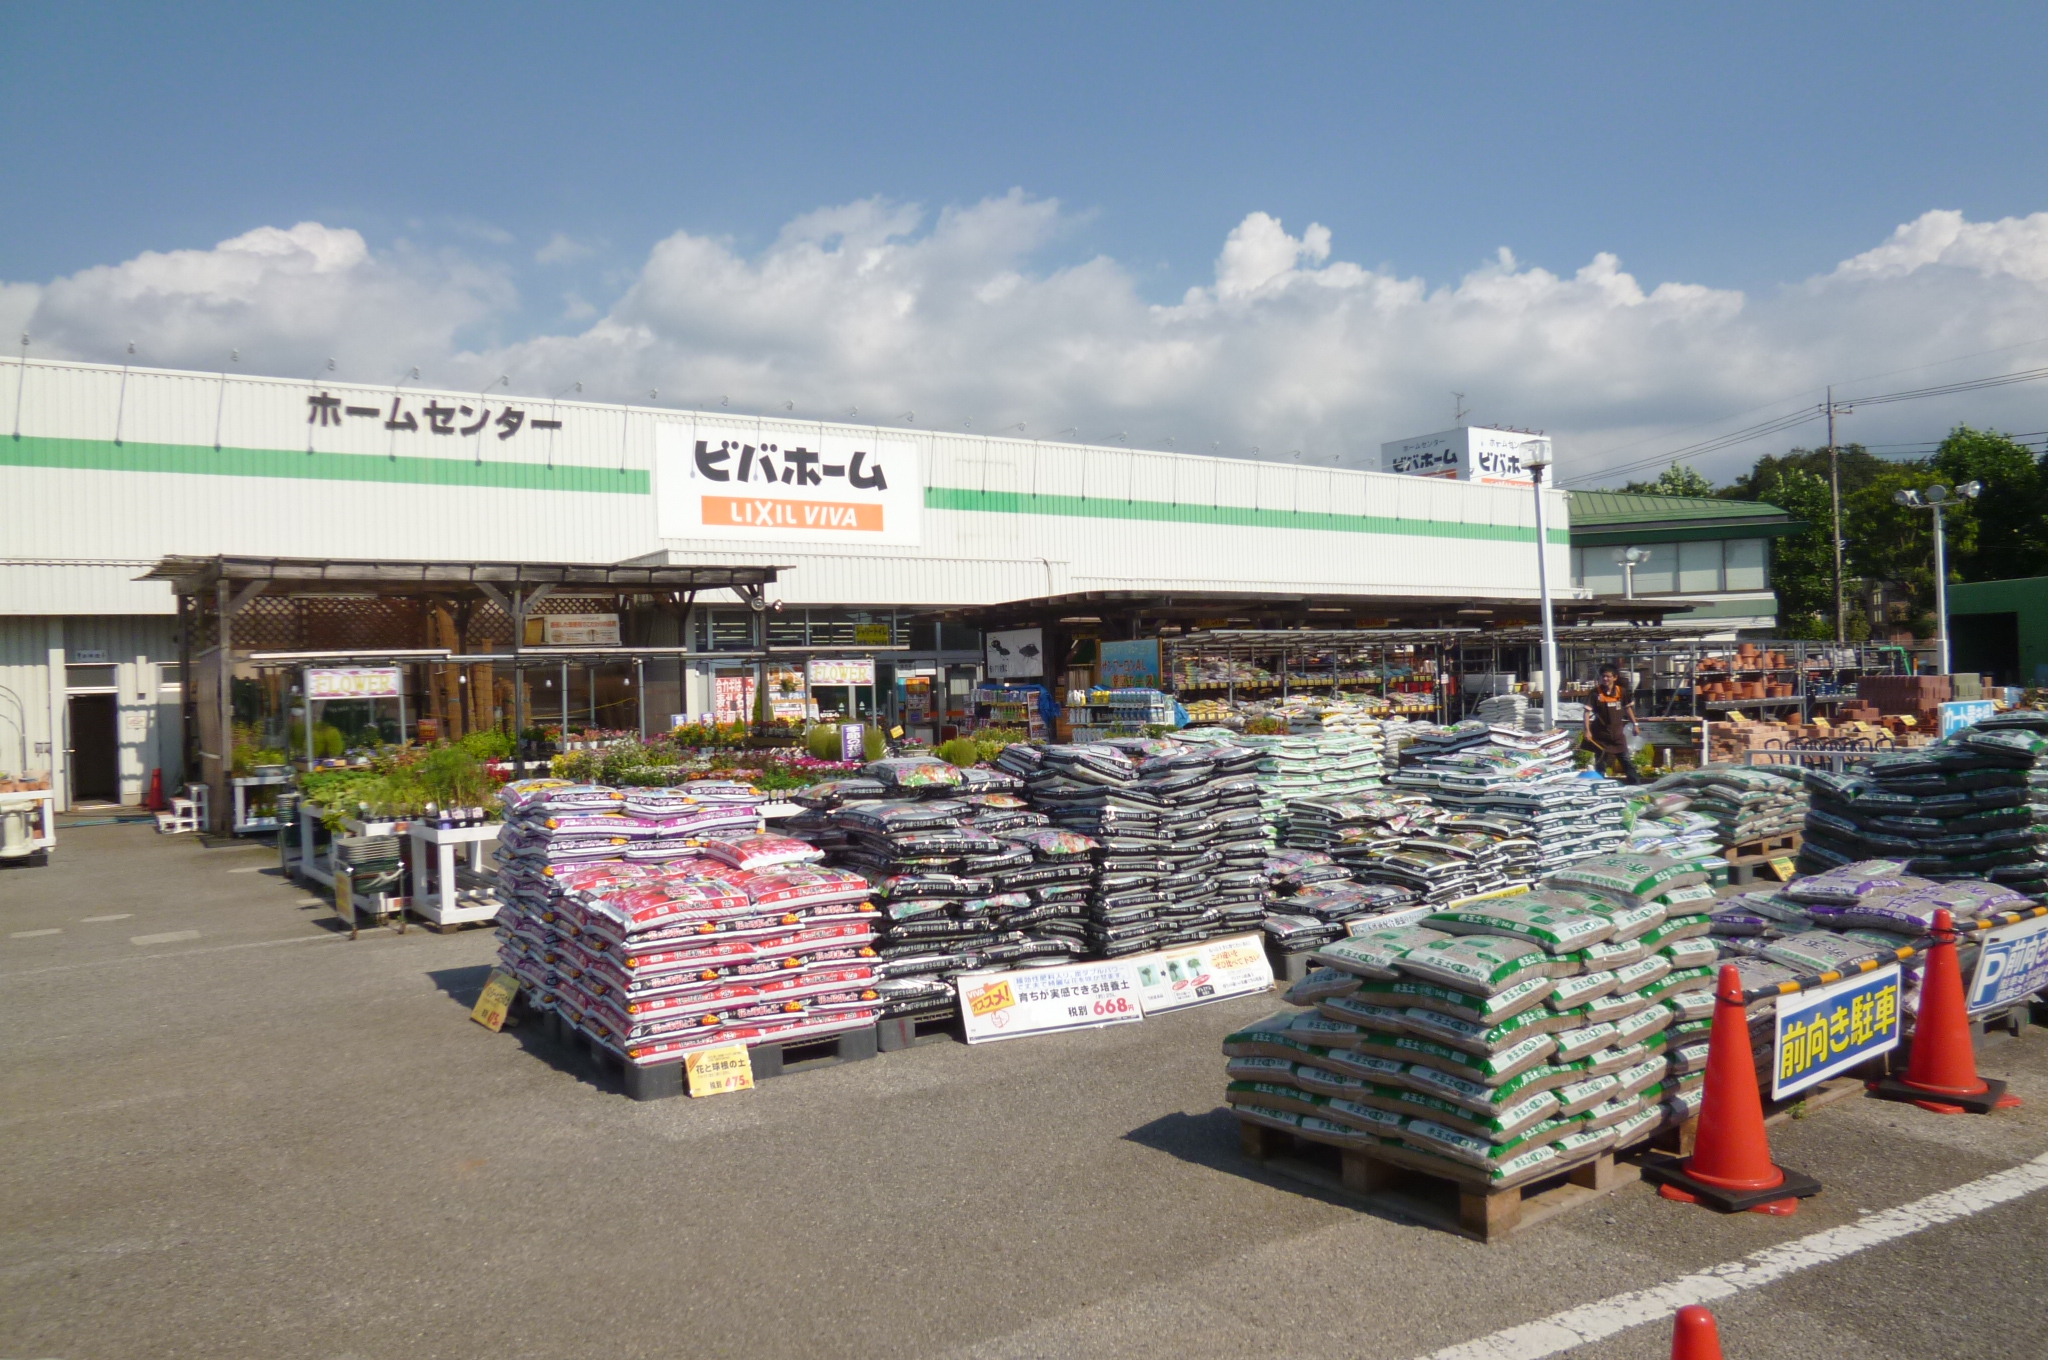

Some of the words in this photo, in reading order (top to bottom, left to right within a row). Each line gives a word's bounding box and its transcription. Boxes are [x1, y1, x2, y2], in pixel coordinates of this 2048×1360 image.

[307, 391, 563, 440] ホームセンター
[1403, 439, 1446, 452] ホームセンター
[694, 439, 888, 492] ビバホーム
[1393, 449, 1458, 473] ビバホーム
[731, 500, 796, 526] LIXIL
[804, 505, 857, 528] VIVA
[316, 674, 392, 692] FLOWER
[814, 666, 867, 681] FLOWER
[1973, 952, 2007, 1002] P
[967, 989, 985, 999] VIVA
[1018, 980, 1130, 1003] 育ちが実感できる培養土
[1068, 1005, 1088, 1018] 税別
[1780, 985, 1897, 1081] 前向き駐車
[696, 1059, 746, 1074] 花と球根の土
